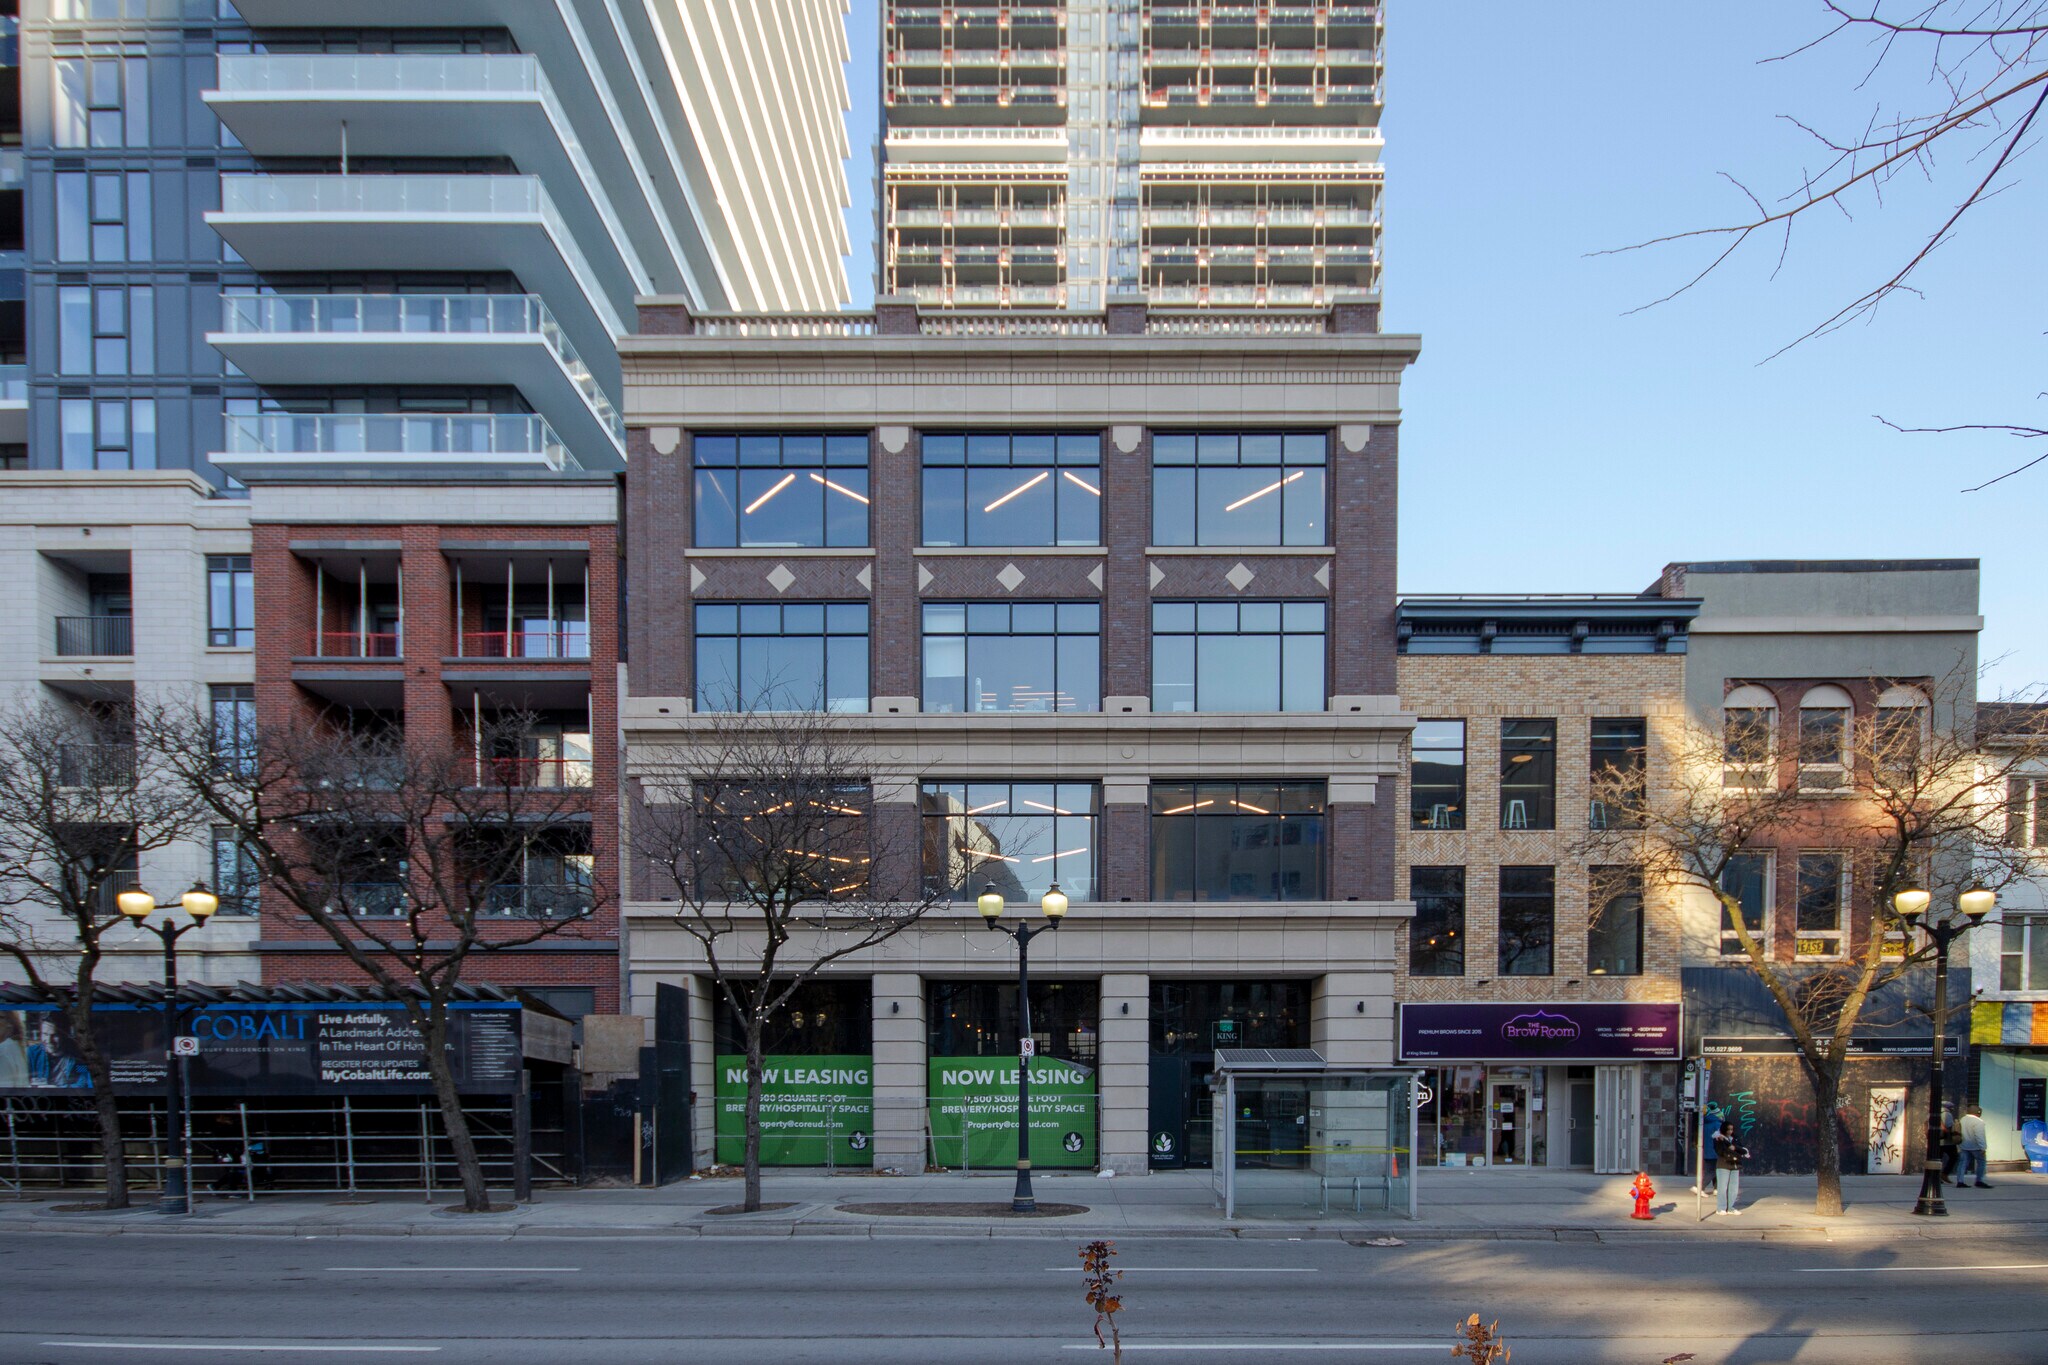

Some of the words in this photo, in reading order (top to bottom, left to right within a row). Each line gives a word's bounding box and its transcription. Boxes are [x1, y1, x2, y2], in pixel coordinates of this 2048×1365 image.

[1798, 942, 1822, 953] EASE
[319, 1014, 343, 1024] Live
[344, 1014, 391, 1026] Artfully.
[191, 1014, 309, 1041] COBALT
[319, 1028, 328, 1037] A
[330, 1028, 384, 1037] Landmark
[385, 1028, 424, 1037] Addre
[1507, 1026, 1541, 1037] Brow
[1541, 1026, 1575, 1038] Room
[1217, 1032, 1238, 1040] KING
[319, 1041, 330, 1050] In
[331, 1041, 352, 1050] The
[355, 1041, 385, 1050] Heart
[387, 1041, 401, 1050] Of
[322, 1060, 360, 1068] REGISTER
[362, 1060, 380, 1068] FOR
[381, 1060, 419, 1068] UPDATES
[784, 1069, 868, 1085] LEASING
[942, 1070, 995, 1085] NOW
[1000, 1069, 1084, 1085] LEASING
[778, 1094, 817, 1102] SQUARE
[839, 1105, 869, 1113] SPACE
[941, 1104, 1052, 1114] BREWERY/HOSPALITY
[1054, 1105, 1085, 1113] SPACE
[967, 1120, 1060, 1130] Property@coud.com
